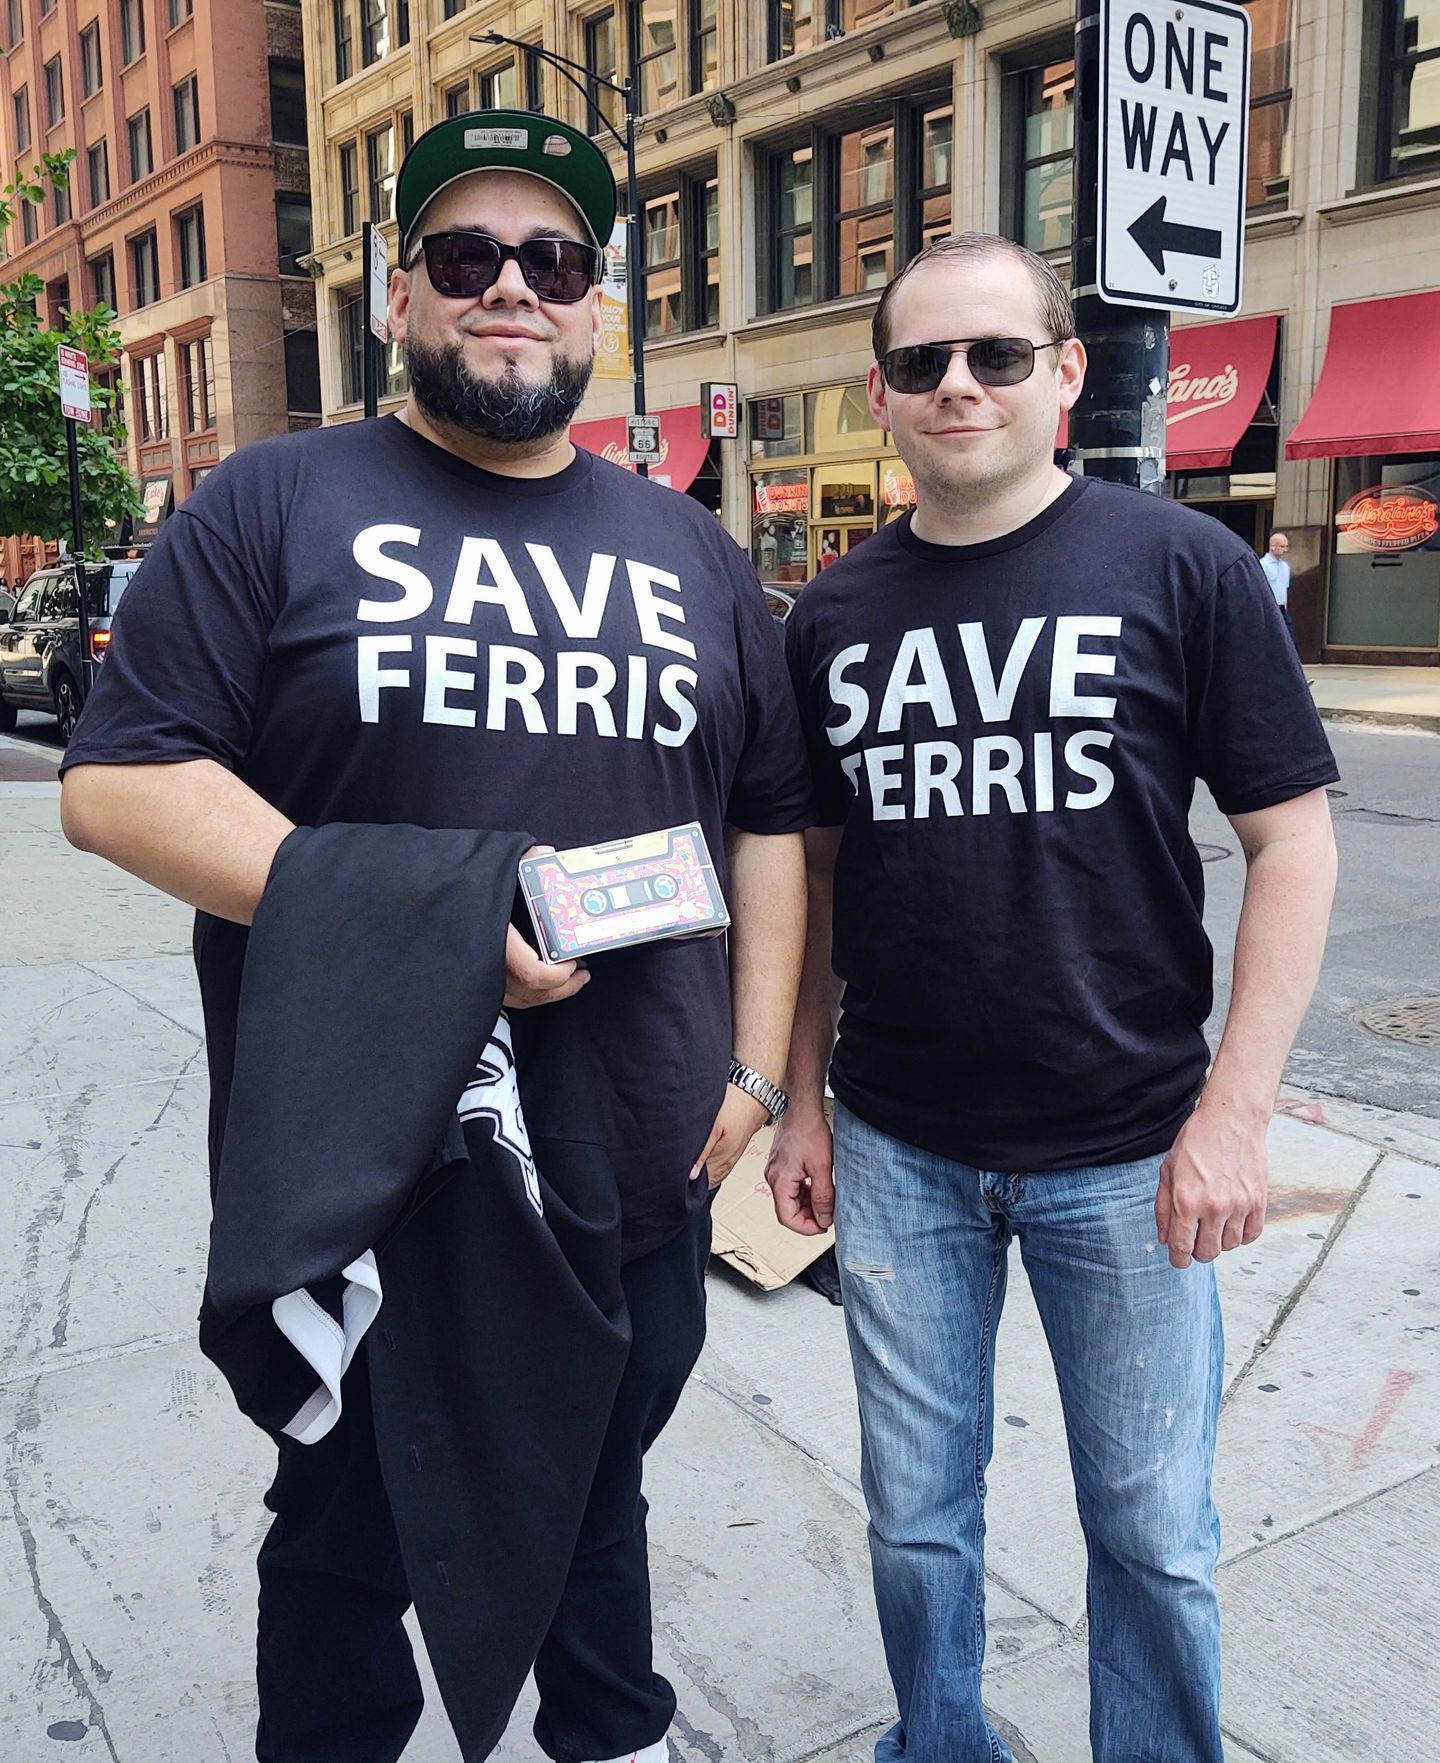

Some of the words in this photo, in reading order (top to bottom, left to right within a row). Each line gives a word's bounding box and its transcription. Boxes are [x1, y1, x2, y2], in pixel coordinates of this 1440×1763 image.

[1124, 12, 1229, 103] ONE
[1120, 98, 1230, 185] WAY
[601, 304, 625, 314] OLLOW
[638, 440, 651, 449] 66
[1351, 497, 1437, 525] Giordano's
[352, 523, 698, 661] SAVE
[357, 634, 699, 748] FERRIS
[825, 615, 1123, 747] SAVE
